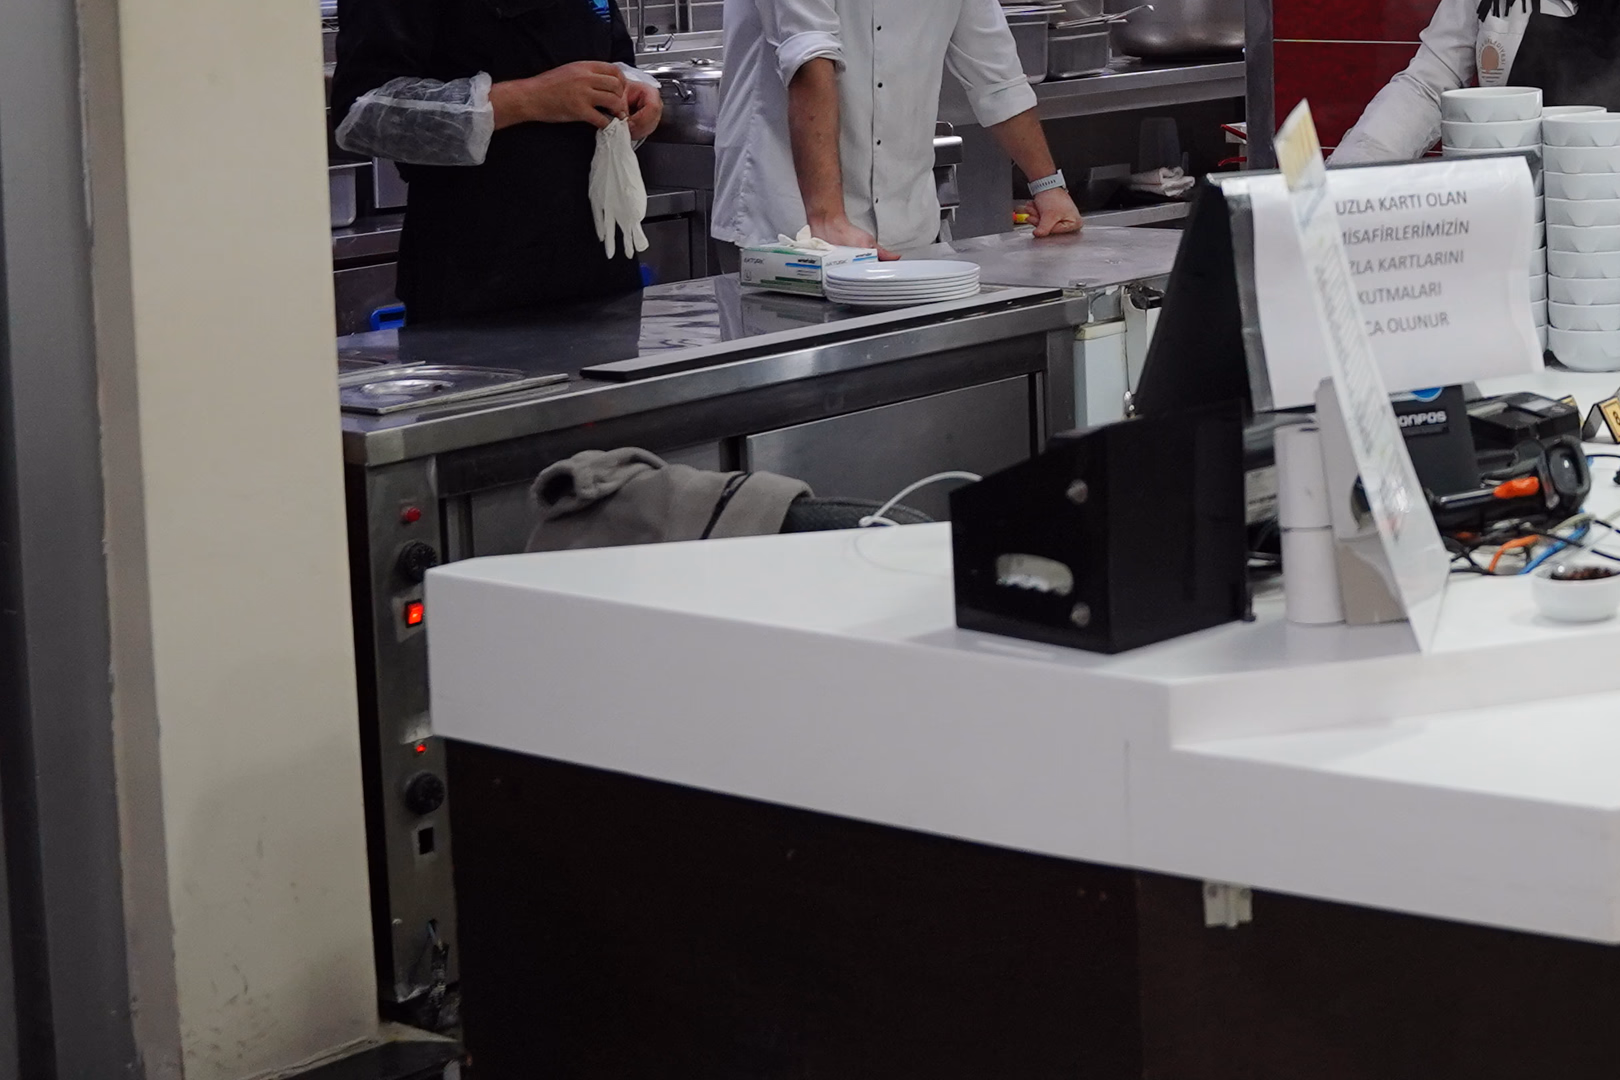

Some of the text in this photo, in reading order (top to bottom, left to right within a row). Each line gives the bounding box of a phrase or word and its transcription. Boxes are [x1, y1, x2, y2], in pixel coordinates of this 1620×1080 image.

[1378, 194, 1422, 212] KARTI
[1426, 191, 1467, 207] OLAN
[1378, 250, 1464, 273] KARTLARINI
[1387, 311, 1450, 334] OLUNUR
